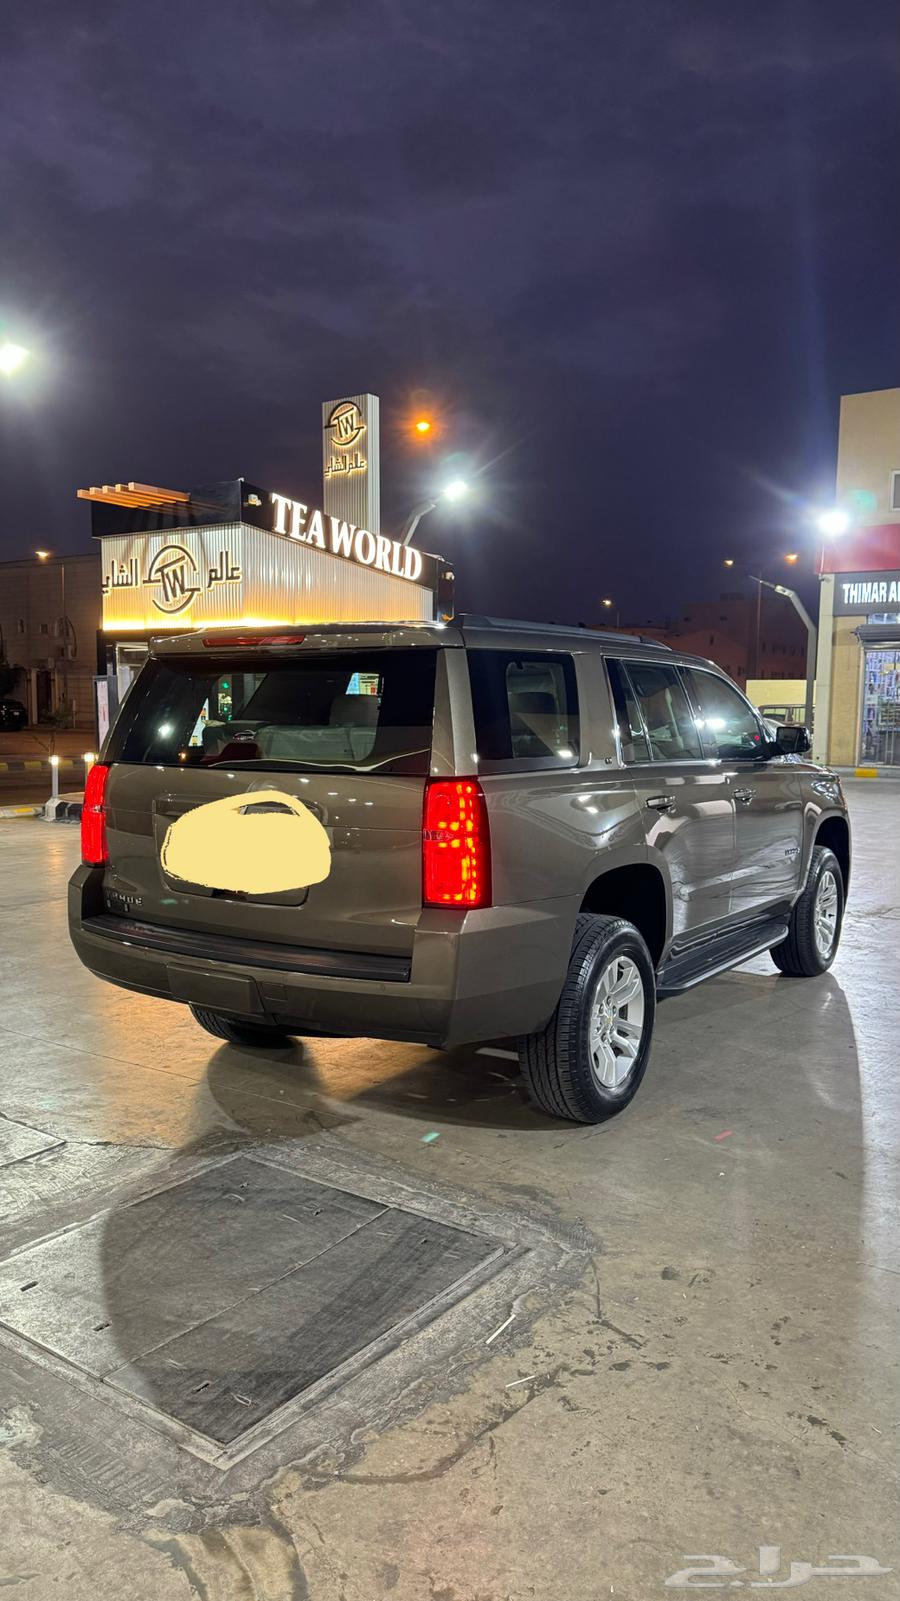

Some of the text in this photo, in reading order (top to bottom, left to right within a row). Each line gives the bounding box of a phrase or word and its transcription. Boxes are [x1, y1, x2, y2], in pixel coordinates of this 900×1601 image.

[271, 492, 422, 580] TEA WORLD
[101, 550, 241, 594] عالم الشاي
[842, 582, 888, 604] THIMAR
